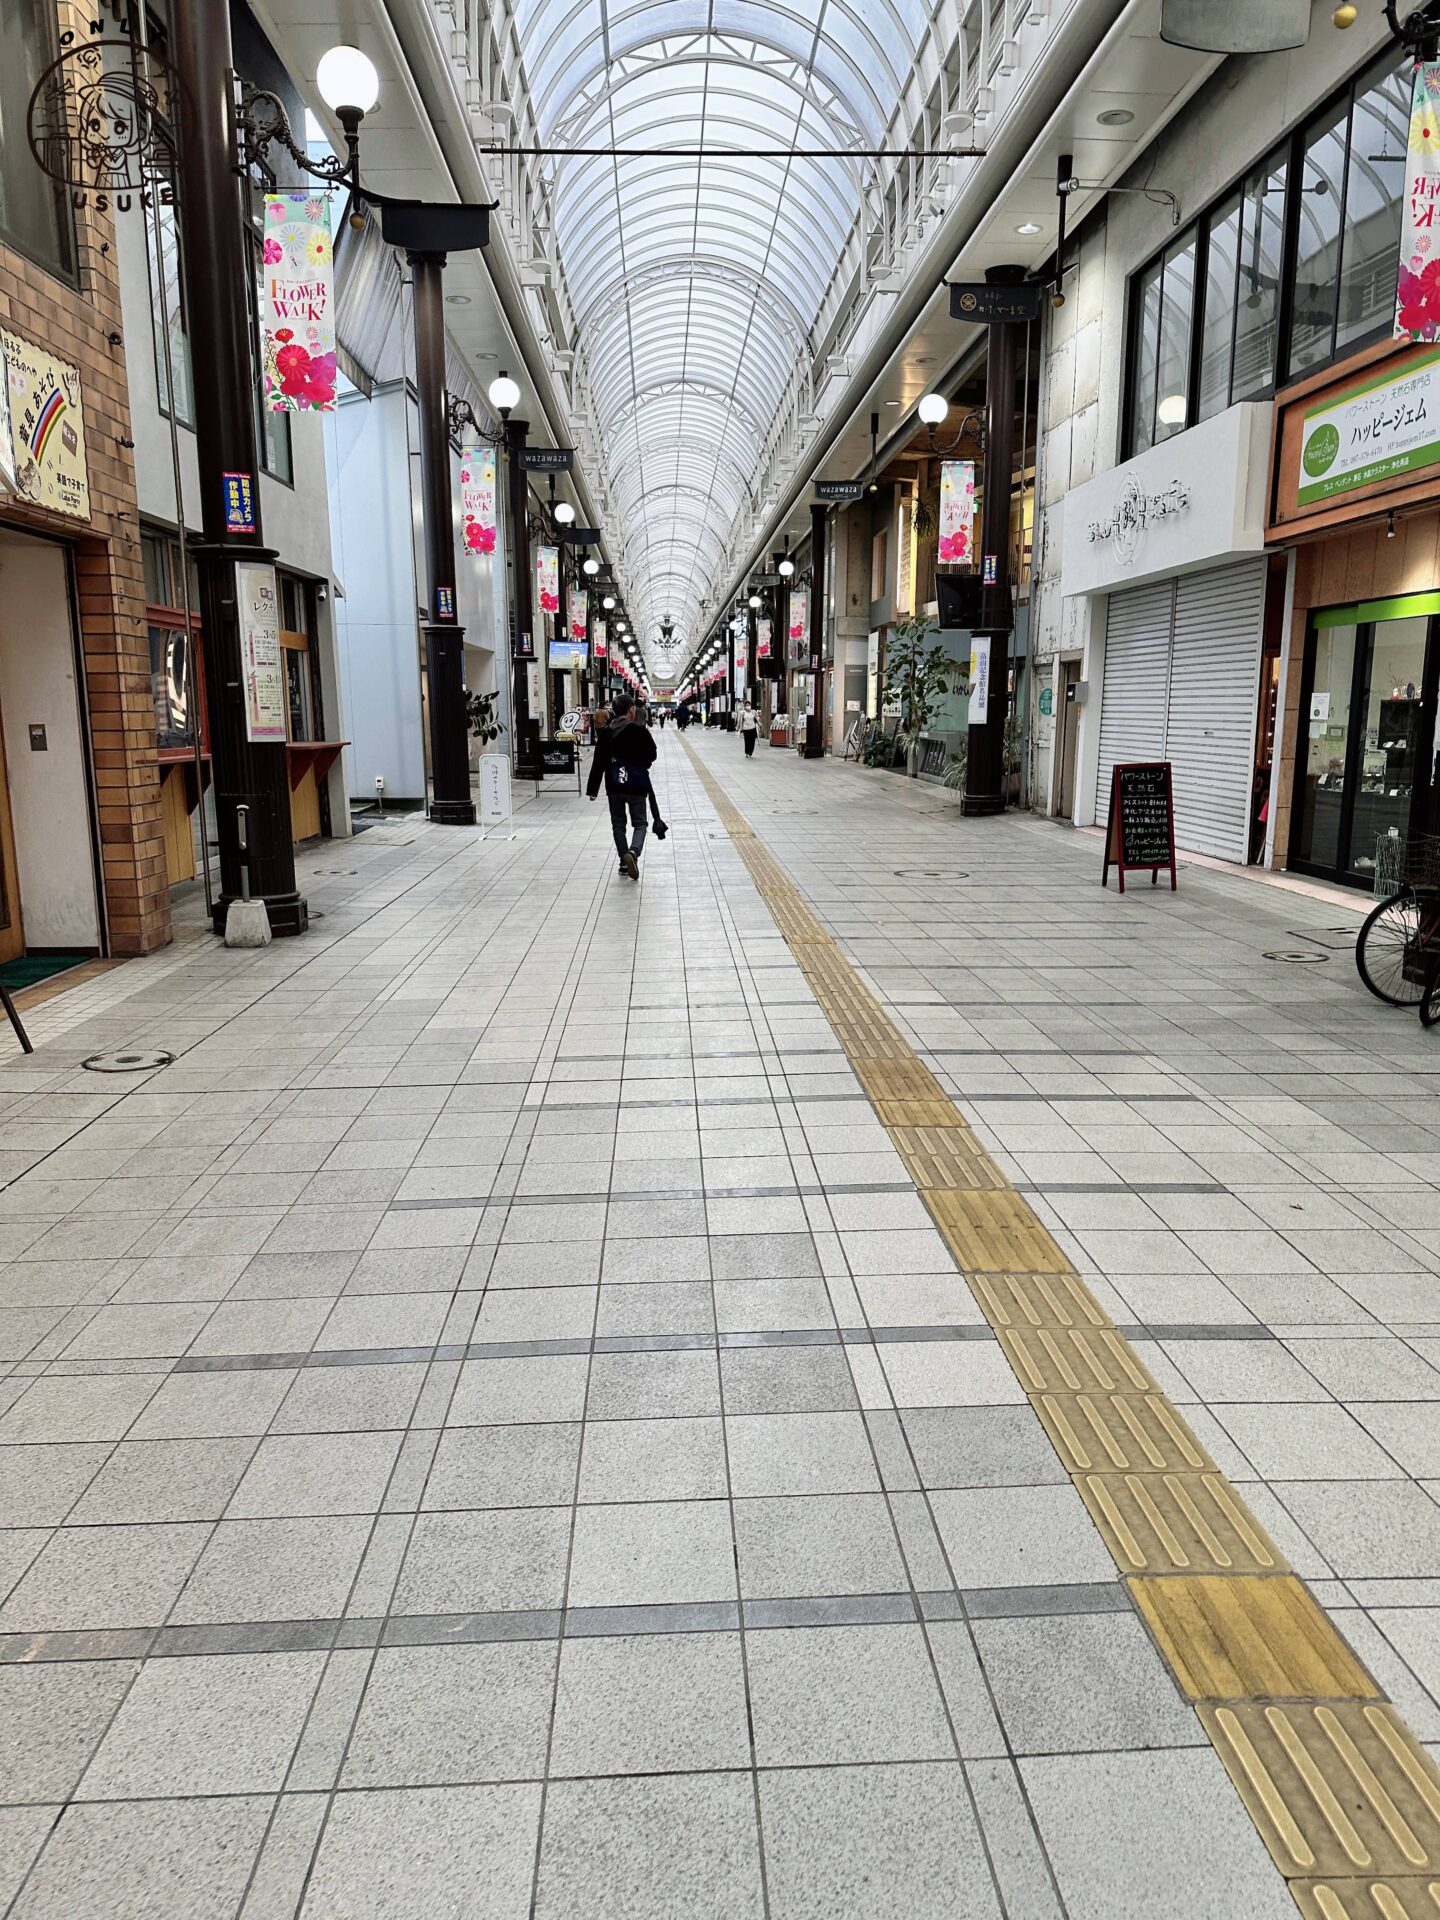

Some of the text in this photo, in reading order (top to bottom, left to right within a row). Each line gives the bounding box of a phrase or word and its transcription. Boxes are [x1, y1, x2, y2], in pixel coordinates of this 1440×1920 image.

[271, 278, 327, 302] FLOWER
[272, 298, 326, 321] WALK!
[1344, 373, 1432, 420] パワーストーン 天然石専門店
[1350, 397, 1427, 446] ハッピージェム
[525, 455, 568, 463] wazawaza
[241, 478, 252, 522] 防犯カメラ
[1121, 772, 1164, 781] パワーストーン
[1127, 784, 1155, 792] 天然石
